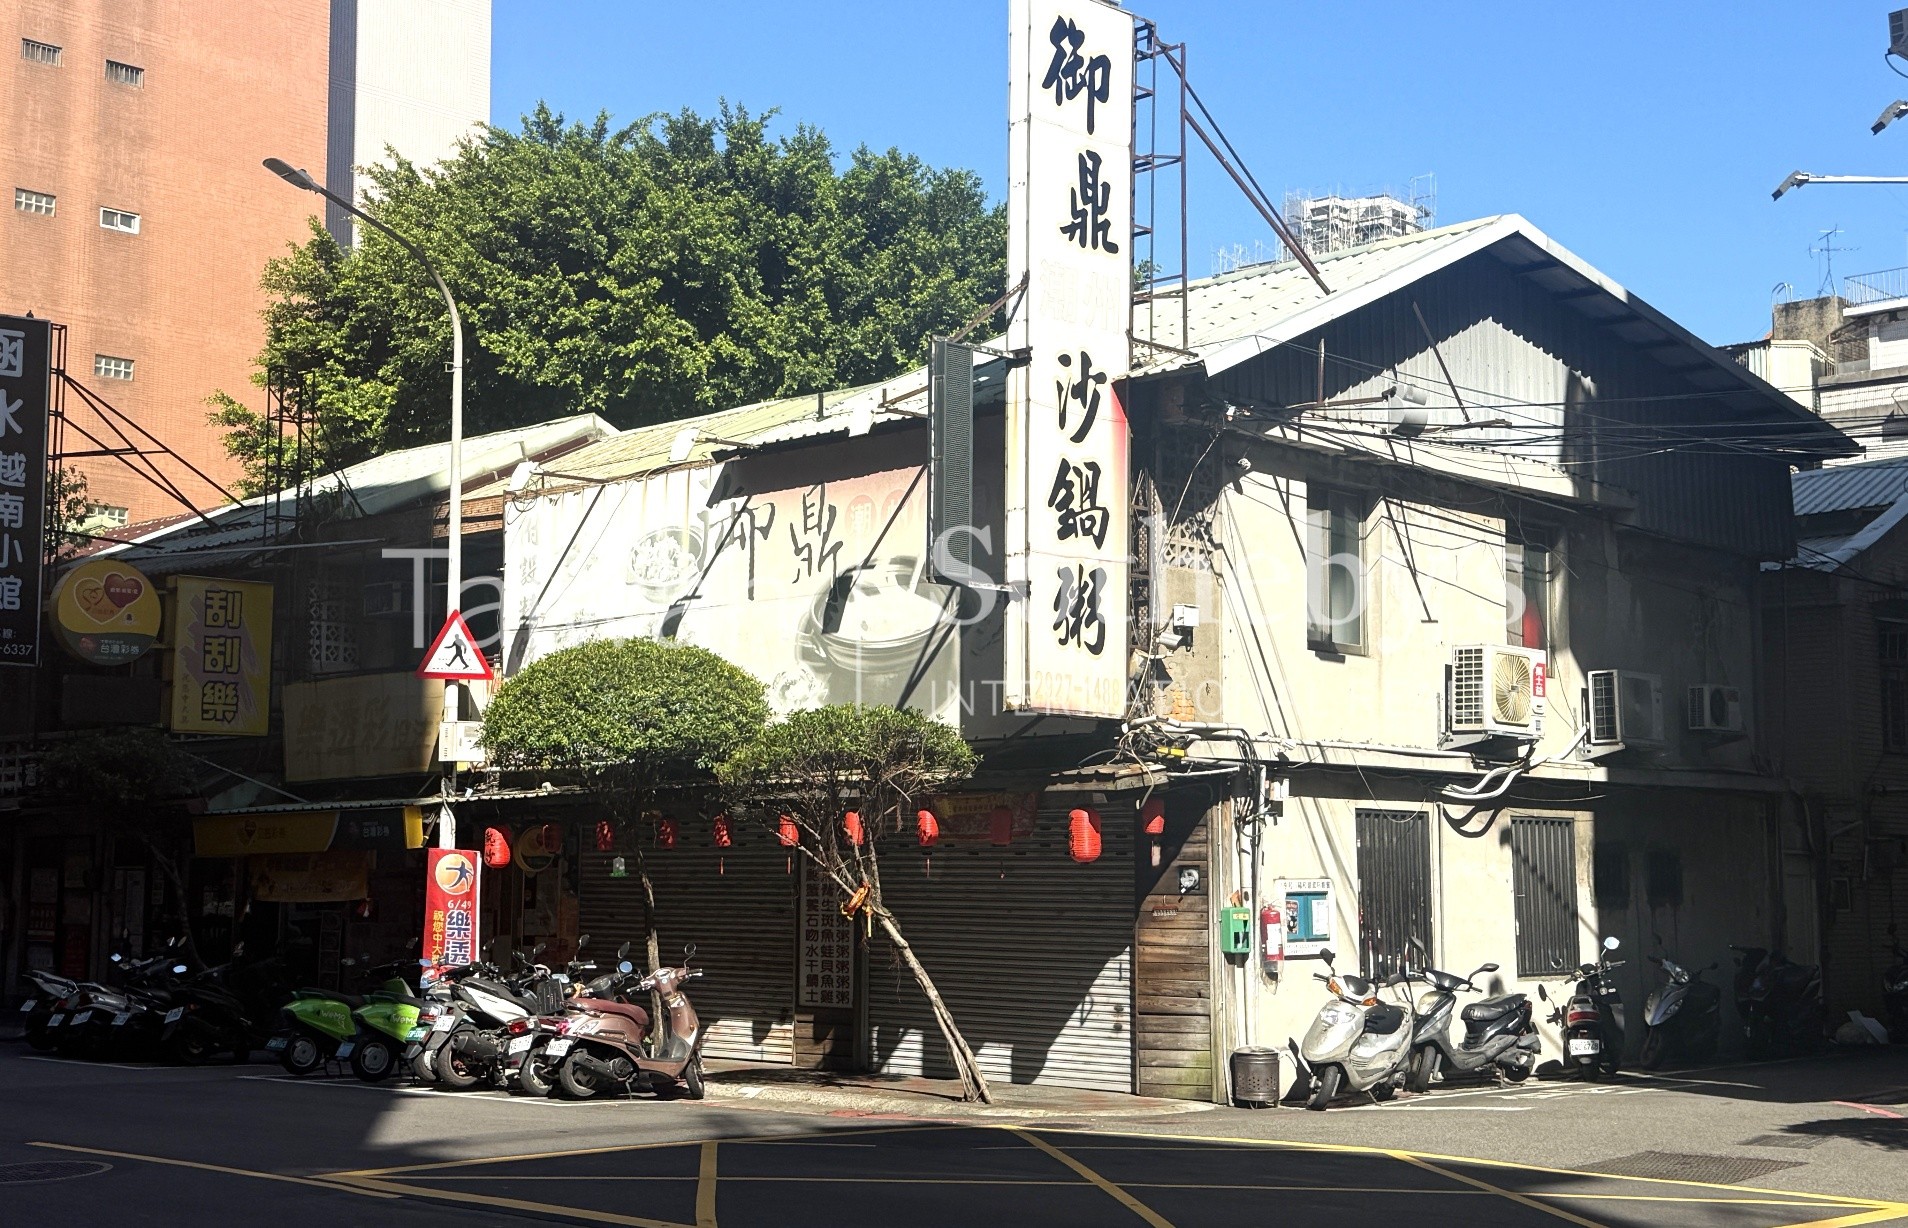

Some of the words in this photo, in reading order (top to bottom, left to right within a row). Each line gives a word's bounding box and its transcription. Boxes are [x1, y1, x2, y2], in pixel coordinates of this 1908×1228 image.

[1042, 15, 1119, 254] 御鼎
[1047, 350, 1110, 656] 沙鍋粥
[201, 589, 243, 724] 刮刮樂
[1035, 671, 1121, 708] 2927-1488
[447, 899, 472, 910] 6/49
